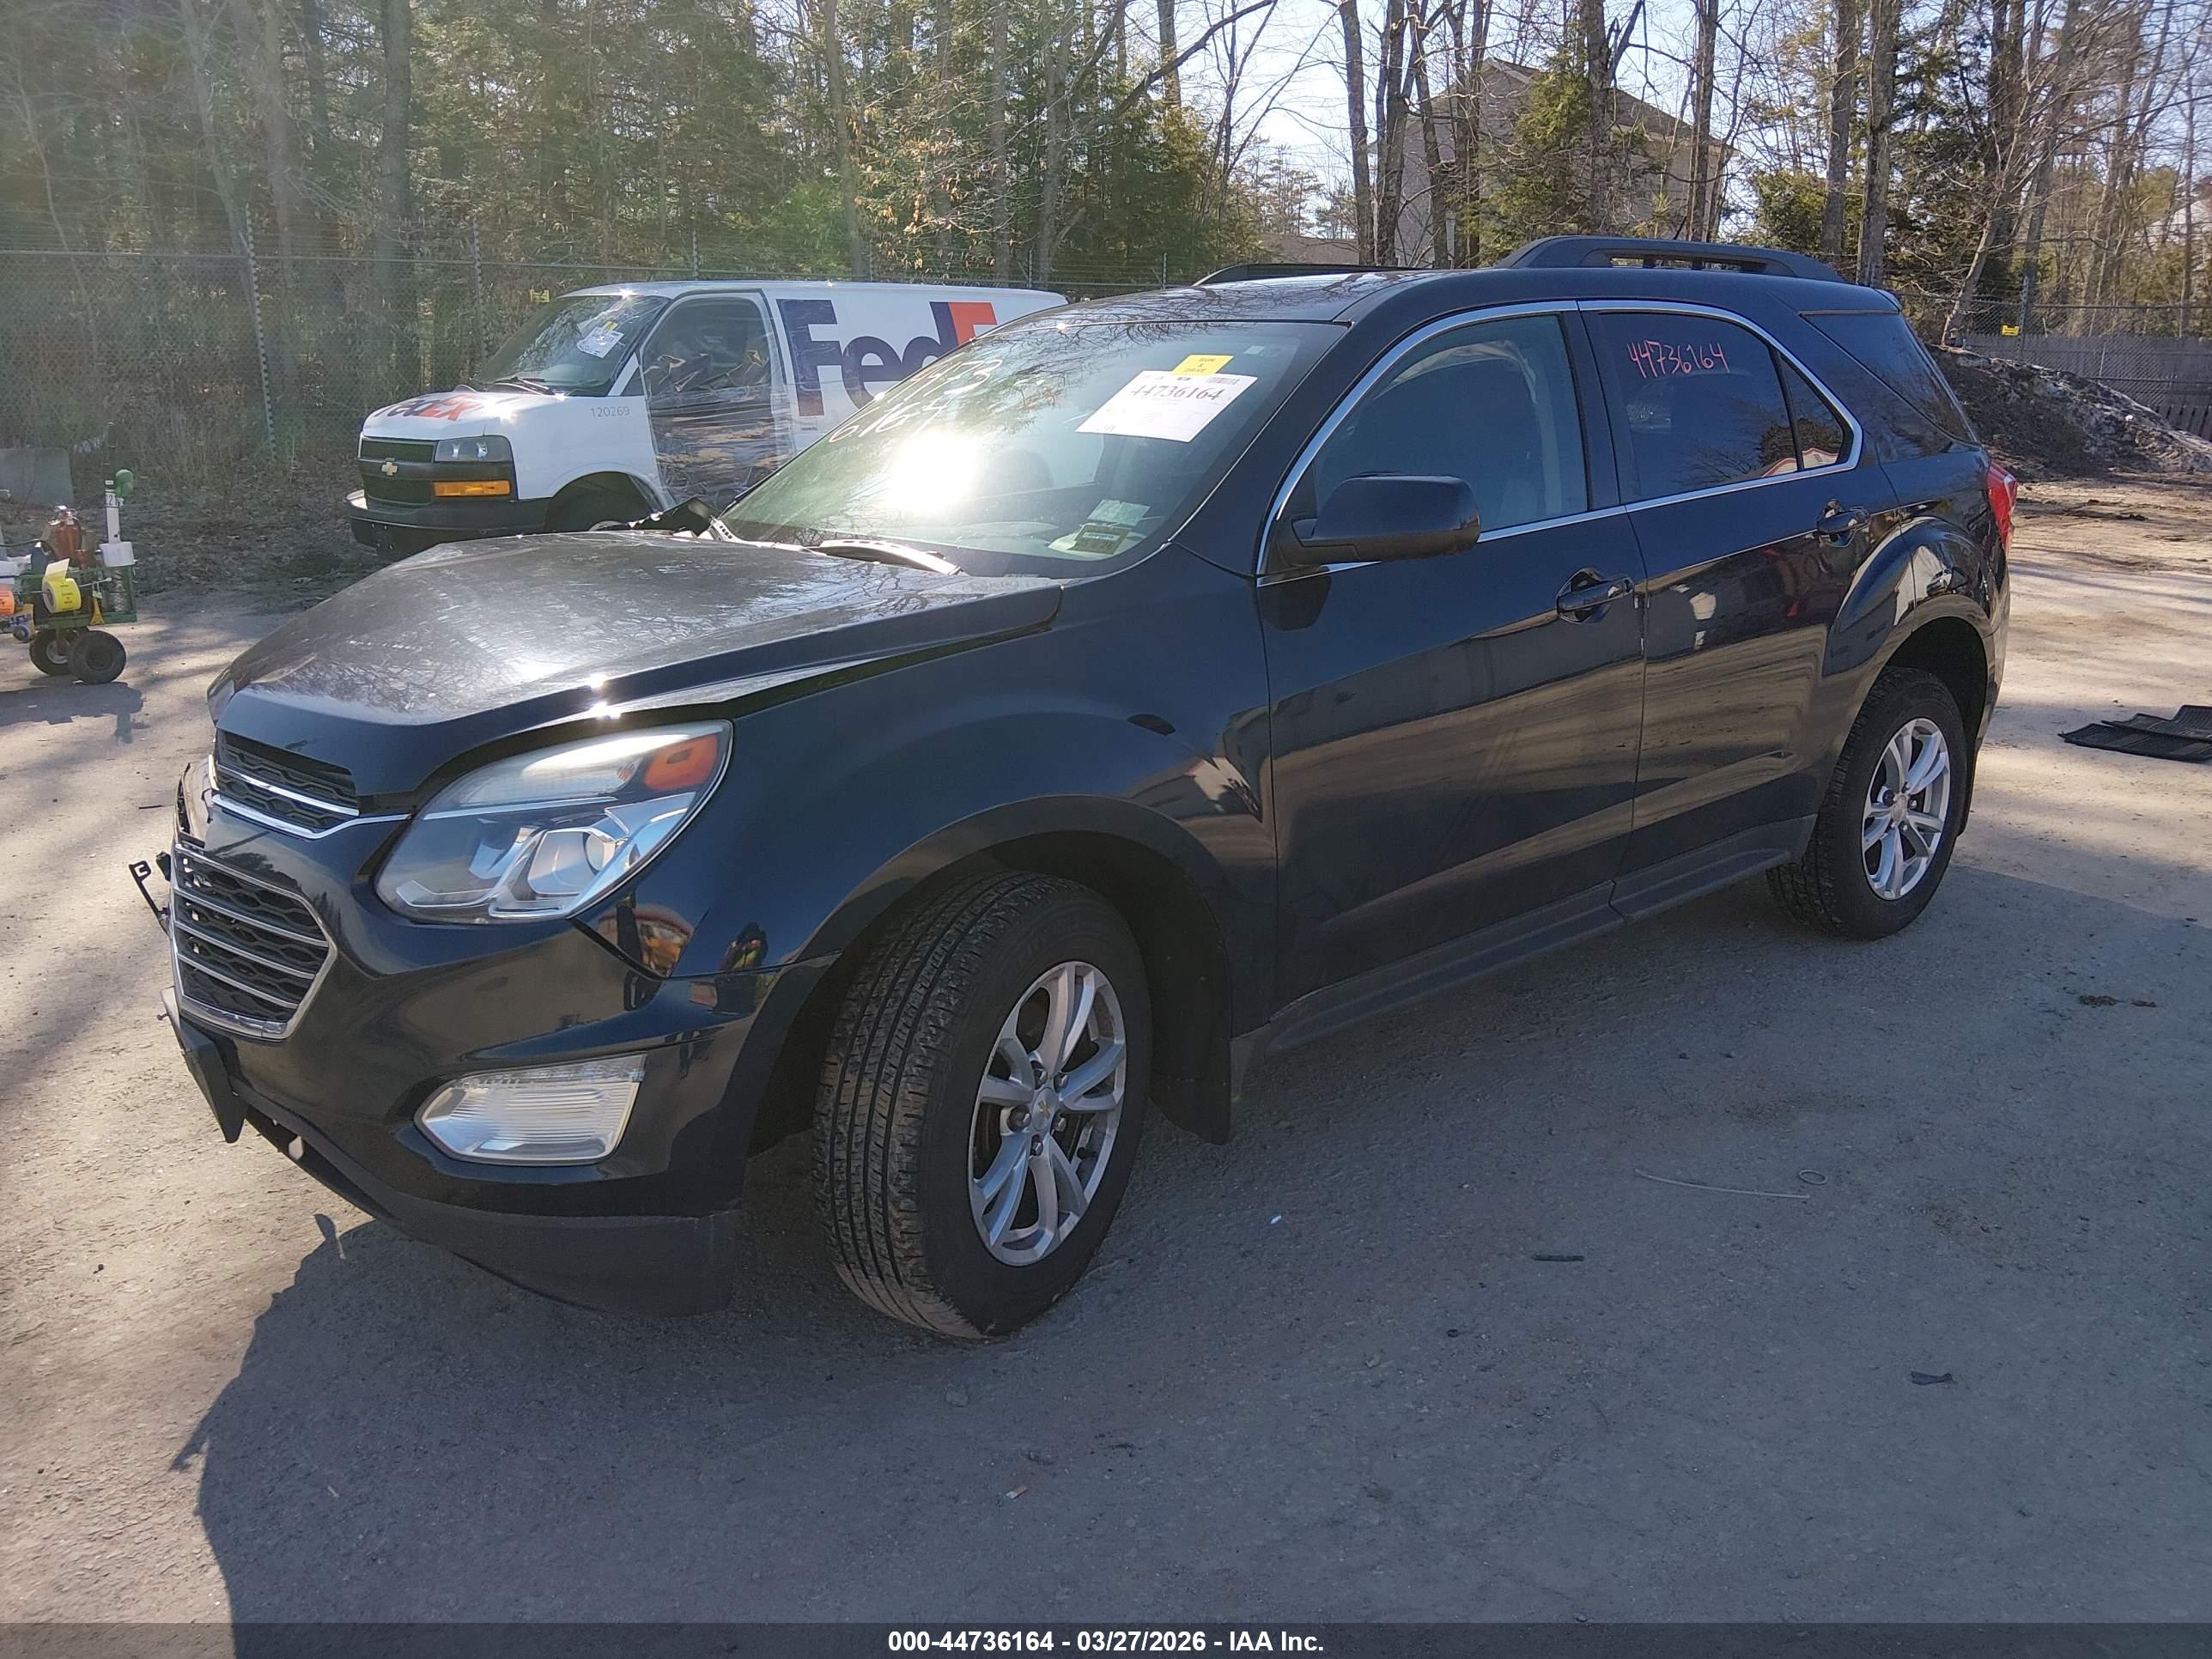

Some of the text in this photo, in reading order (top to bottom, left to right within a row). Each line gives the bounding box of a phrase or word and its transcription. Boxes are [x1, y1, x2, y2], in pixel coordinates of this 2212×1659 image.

[1626, 339, 1730, 379] 44736164
[1131, 384, 1226, 401] 44736164
[590, 405, 630, 419] 120269
